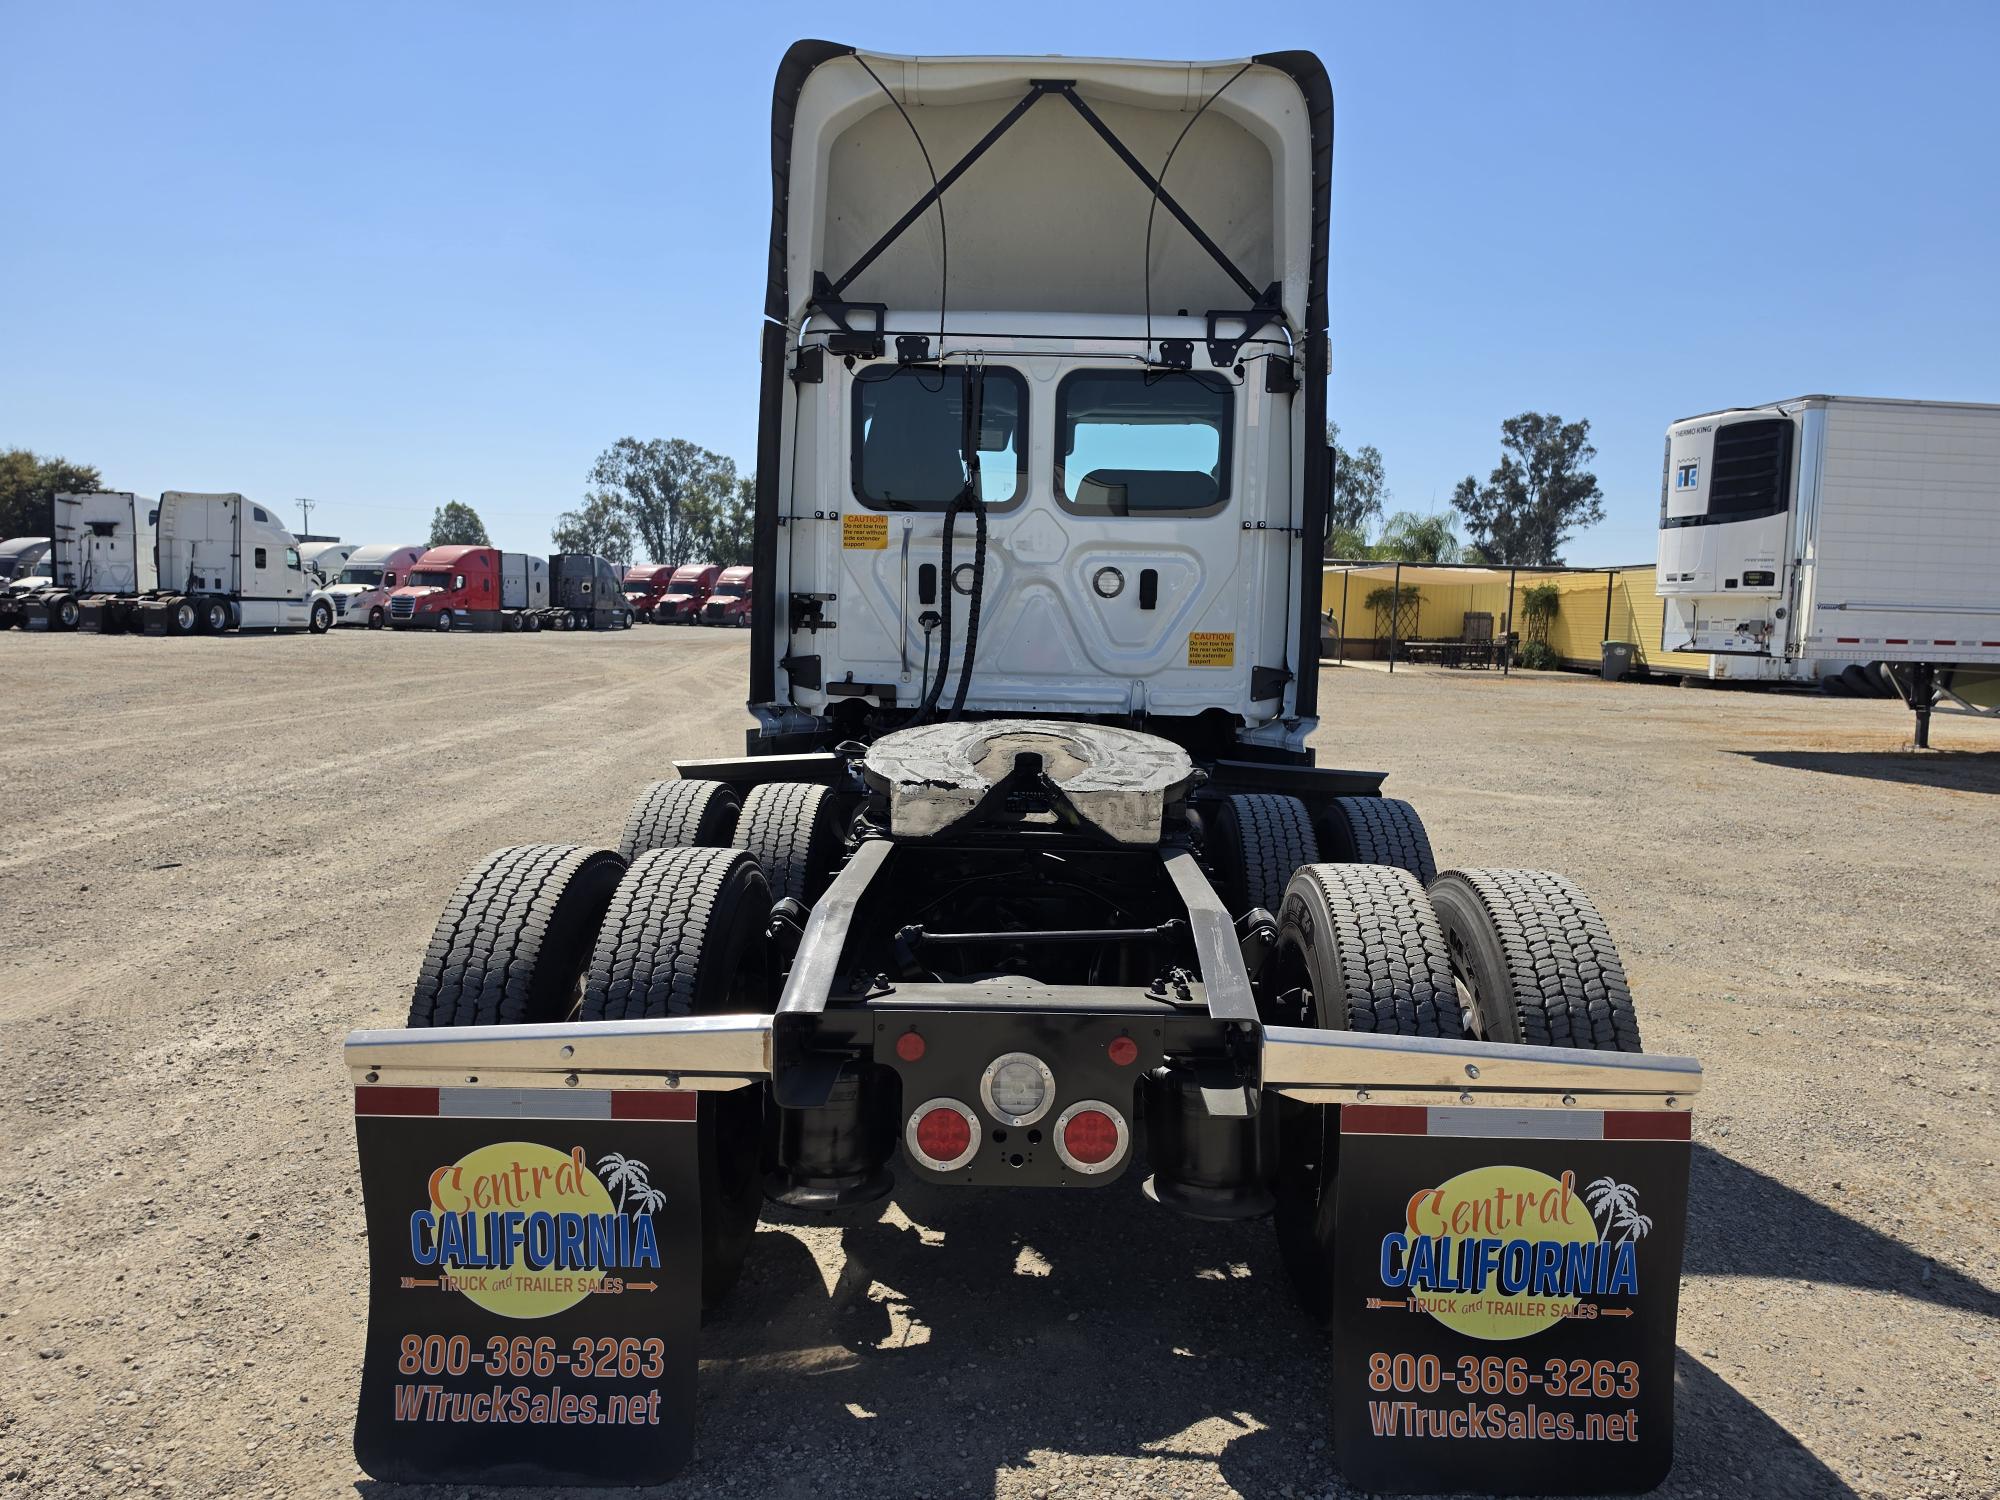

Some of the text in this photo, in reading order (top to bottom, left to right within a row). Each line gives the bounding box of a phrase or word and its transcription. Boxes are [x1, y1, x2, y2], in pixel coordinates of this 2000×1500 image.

[1675, 425, 1713, 437] THERMO KING
[847, 515, 884, 523] CAUTION
[429, 1145, 591, 1216] Central
[1405, 1169, 1576, 1240] Central
[410, 1209, 661, 1271] CALIFORNIA
[439, 1272, 624, 1294] TRUCK and TRAILER SALES
[1380, 1231, 1639, 1297] CALIFORNIA
[1407, 1296, 1598, 1320] TRUCK and TRAILER SALES
[398, 1334, 665, 1379] 800-366-3263
[1368, 1352, 1640, 1399] 800-366-3263
[394, 1384, 662, 1426] WTruckSales.net
[1368, 1401, 1639, 1443] WTruckSales.net
